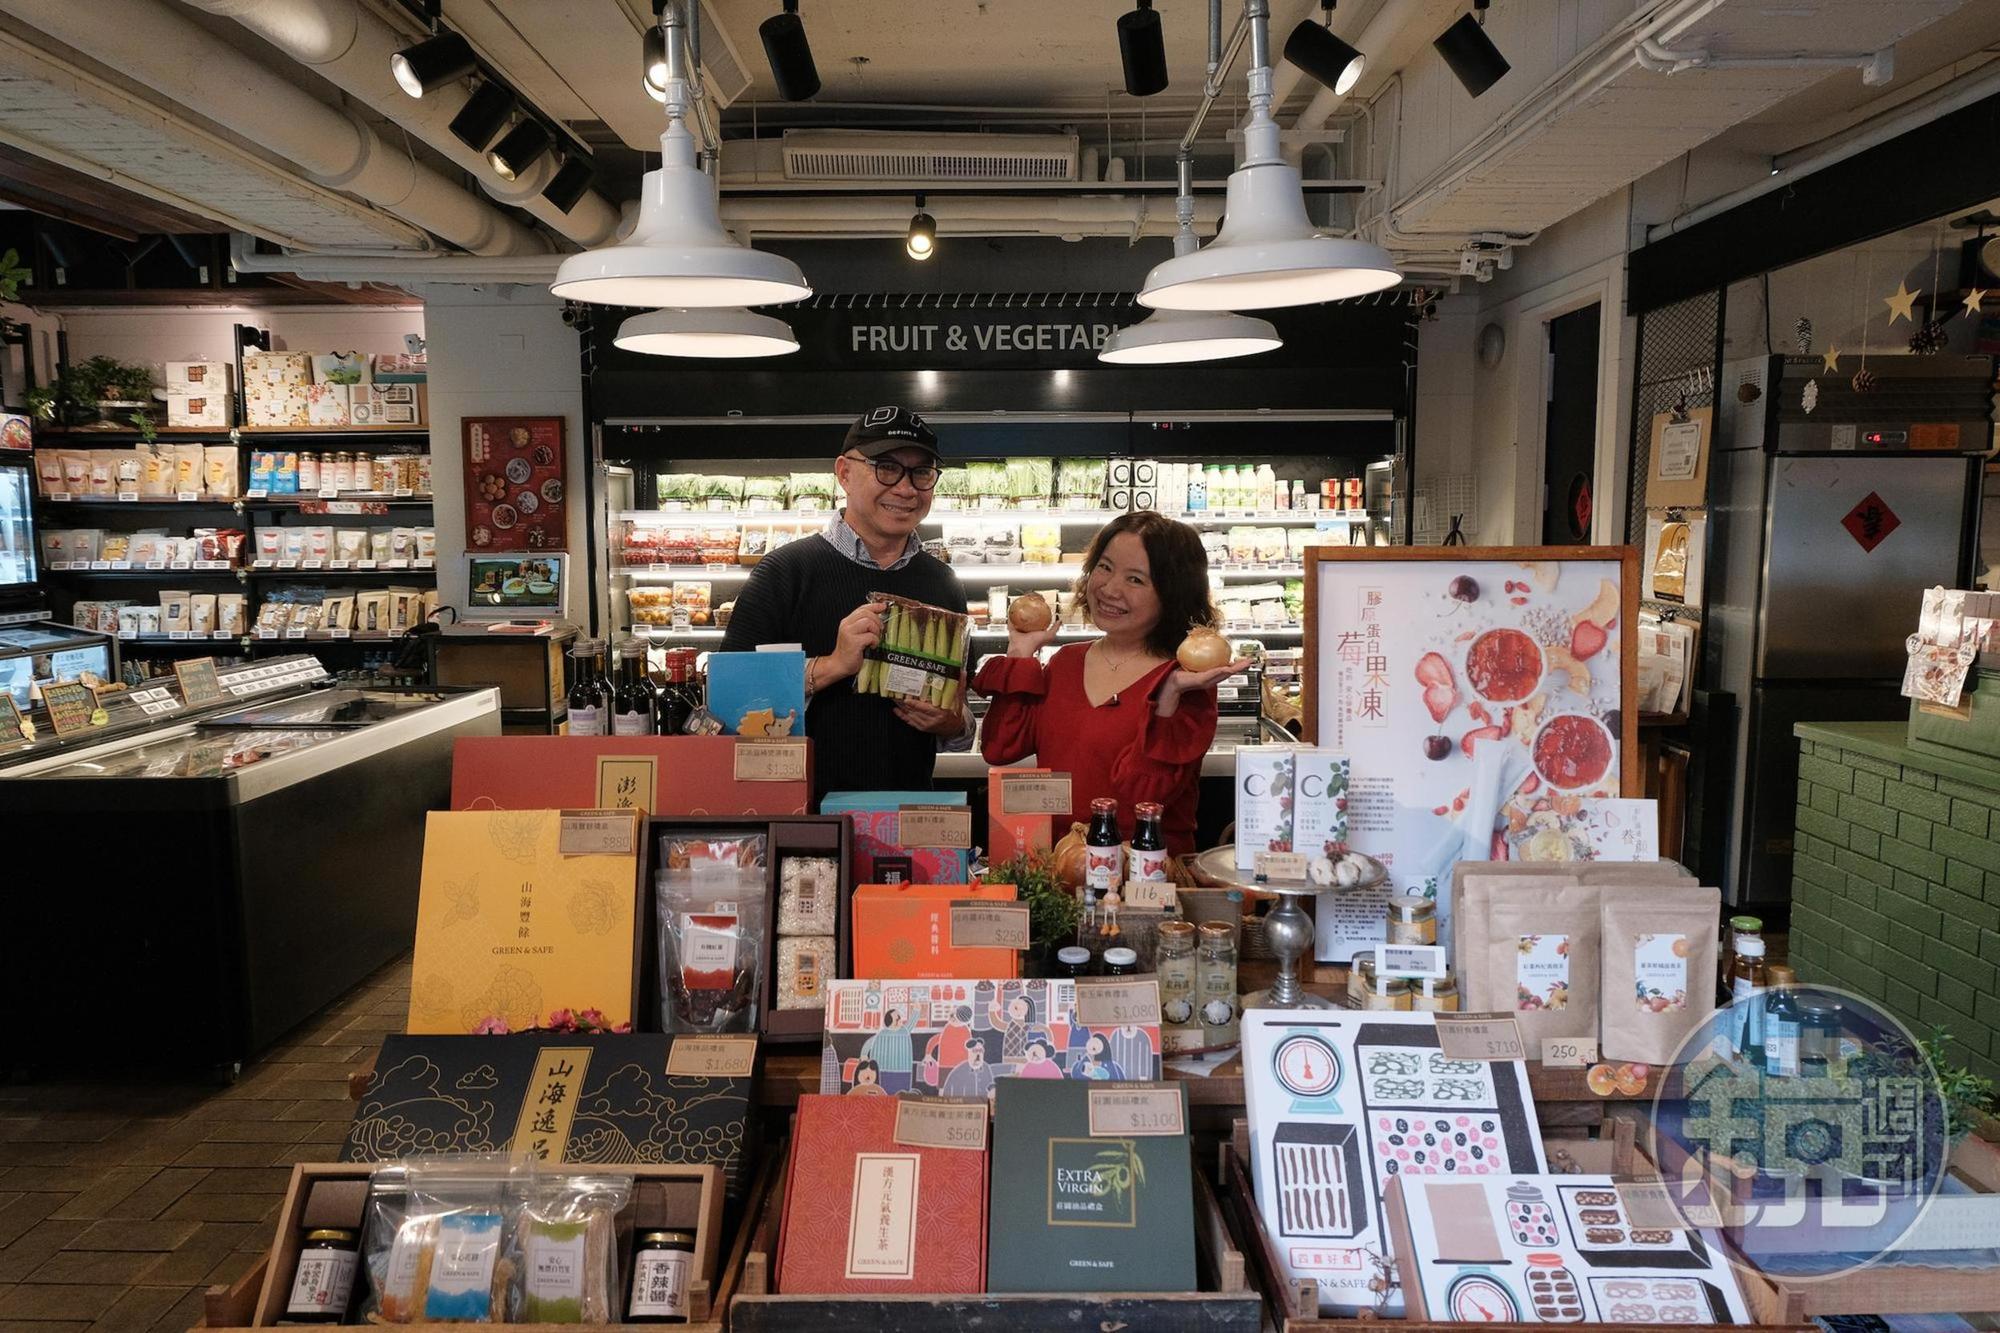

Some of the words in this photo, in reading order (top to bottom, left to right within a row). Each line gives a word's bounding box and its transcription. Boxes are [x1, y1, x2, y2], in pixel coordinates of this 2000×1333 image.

[852, 325, 938, 351] FRUIT
[946, 325, 967, 350] &
[887, 653, 918, 665] GREEN
[926, 663, 946, 673] SAFE
[1134, 886, 1157, 900] 116
[995, 929, 1024, 942] $250
[492, 946, 522, 954] GREEN
[524, 946, 530, 954] &
[532, 945, 554, 954] SAFE
[1113, 1004, 1155, 1019] $1,080
[1487, 1041, 1518, 1053] $710
[1551, 1045, 1577, 1059] 250
[705, 1058, 748, 1070] $1,680
[1130, 1113, 1177, 1127] $1,100
[947, 1127, 980, 1141] $560
[1057, 1168, 1102, 1182] EXTRA
[1057, 1182, 1103, 1193] VIRGIN
[1098, 1260, 1114, 1268] SAFE
[1340, 1279, 1367, 1288] SAFE
